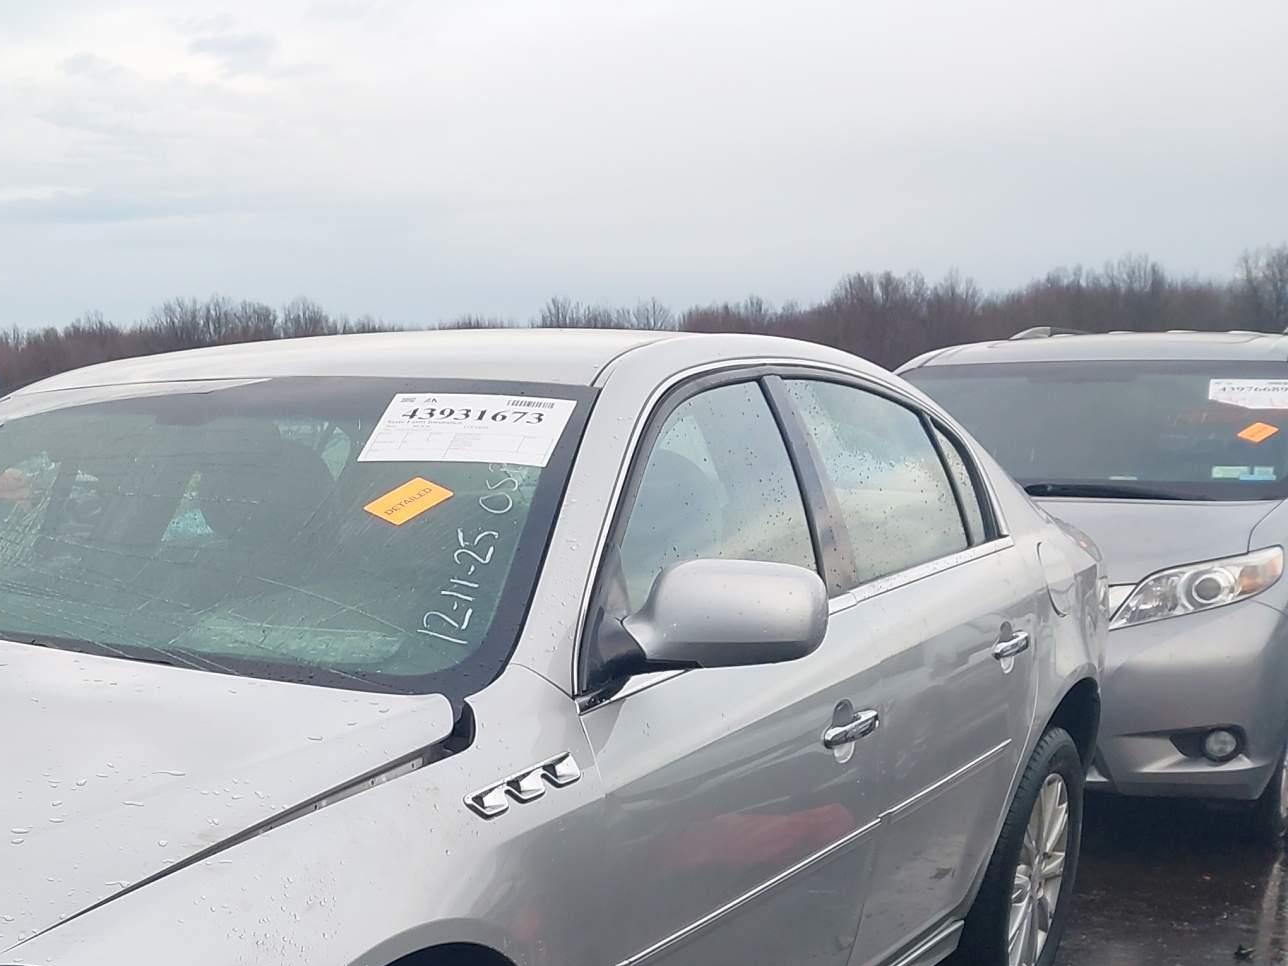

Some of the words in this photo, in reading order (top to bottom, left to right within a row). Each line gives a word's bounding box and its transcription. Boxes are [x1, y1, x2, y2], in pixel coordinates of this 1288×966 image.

[400, 407, 545, 425] 43931673
[384, 487, 432, 516] DETAILED
[416, 527, 499, 644] 12-11-25
